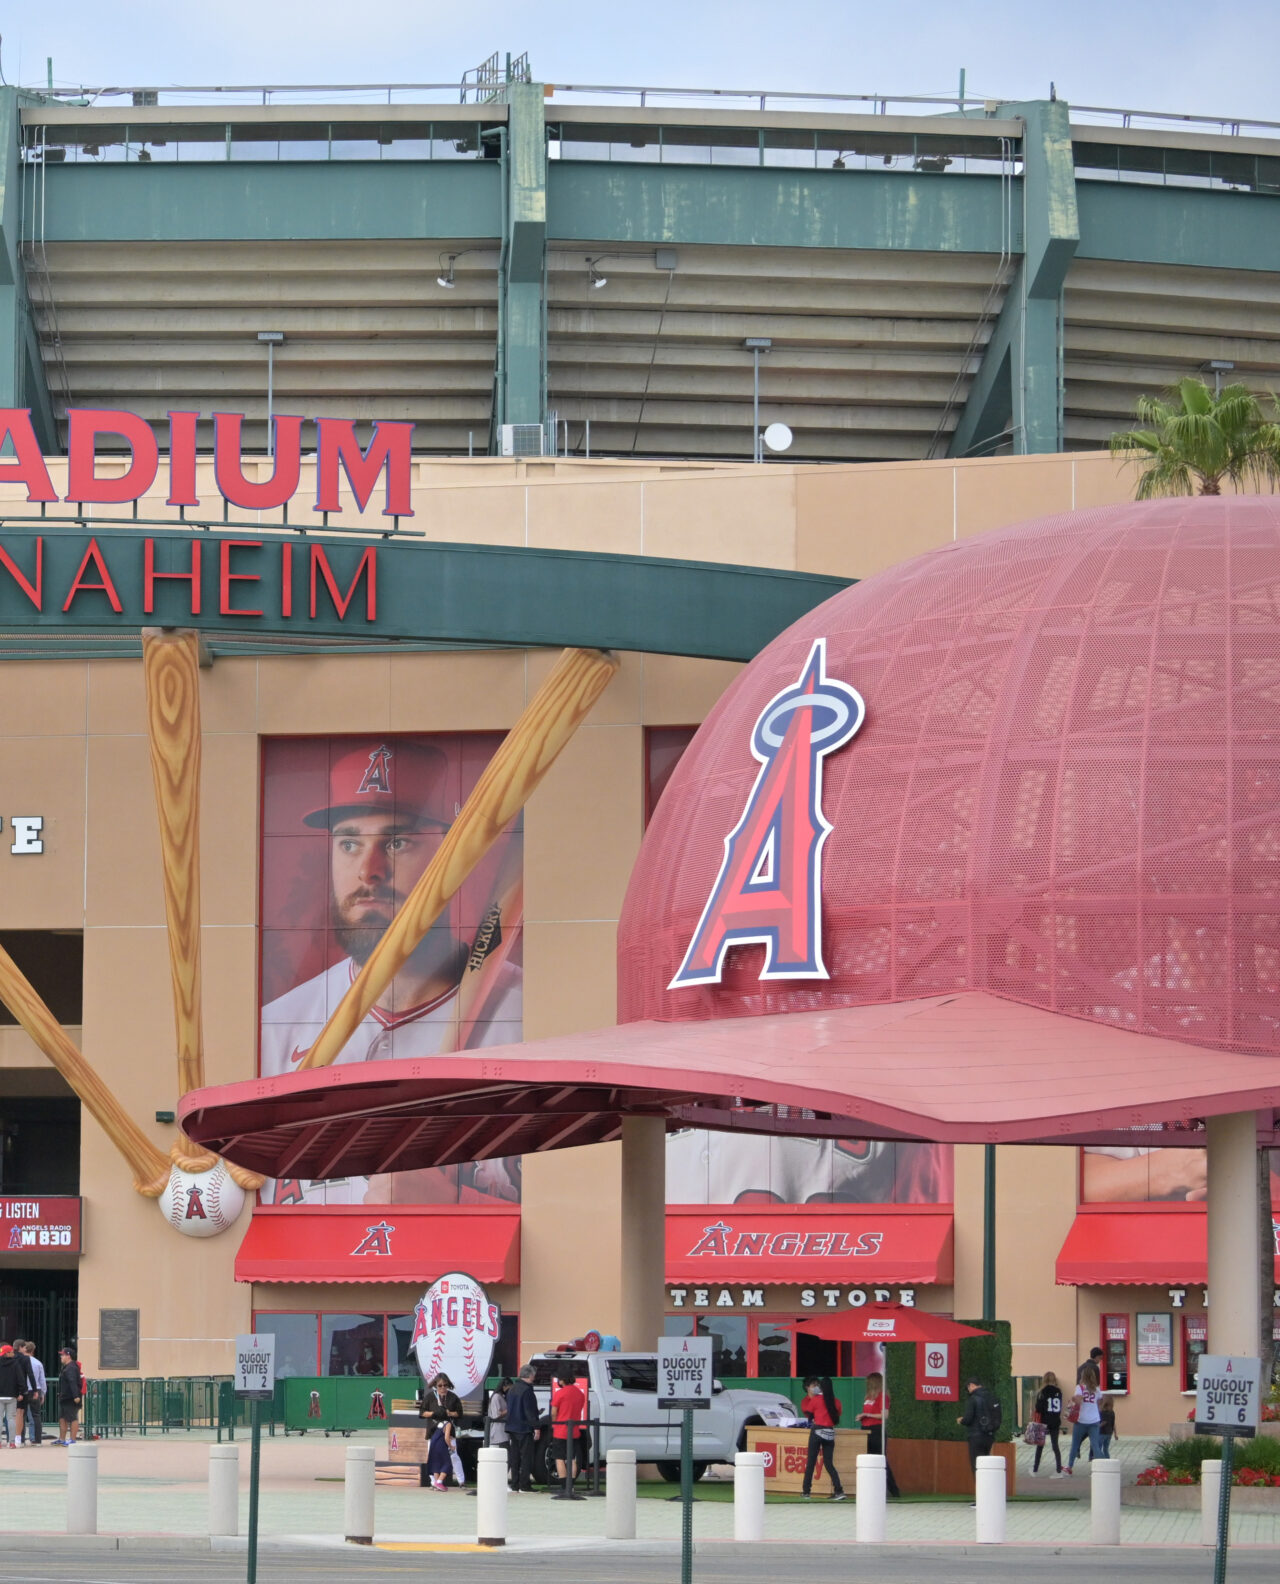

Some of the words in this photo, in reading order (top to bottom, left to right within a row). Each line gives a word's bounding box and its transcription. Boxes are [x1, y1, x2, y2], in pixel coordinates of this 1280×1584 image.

[666, 637, 866, 990] A
[469, 902, 502, 970] HICKORY
[186, 1184, 208, 1220] A
[6, 1202, 40, 1219] LISTEN
[40, 1231, 72, 1245] 830
[350, 1221, 396, 1256] A
[686, 1221, 884, 1257] ANGELS
[670, 1289, 764, 1307] TEAM
[410, 1297, 499, 1349] ANGELS
[239, 1353, 271, 1364] DUGOUT
[663, 1358, 707, 1369] DUGOUT
[241, 1364, 268, 1374] SUITES
[666, 1369, 703, 1381] SUITES
[243, 1376, 247, 1388] 1
[261, 1376, 267, 1388] 2
[668, 1383, 675, 1396] 3
[694, 1382, 702, 1396] 4
[1203, 1378, 1254, 1393] DUGOUT
[921, 1385, 951, 1395] TOYOTA
[1083, 1392, 1096, 1403] 22
[1047, 1397, 1061, 1412] 19
[1206, 1392, 1249, 1406] SUITES
[1207, 1406, 1215, 1420] 5
[1237, 1408, 1246, 1423] 6
[784, 1455, 824, 1480] eay
